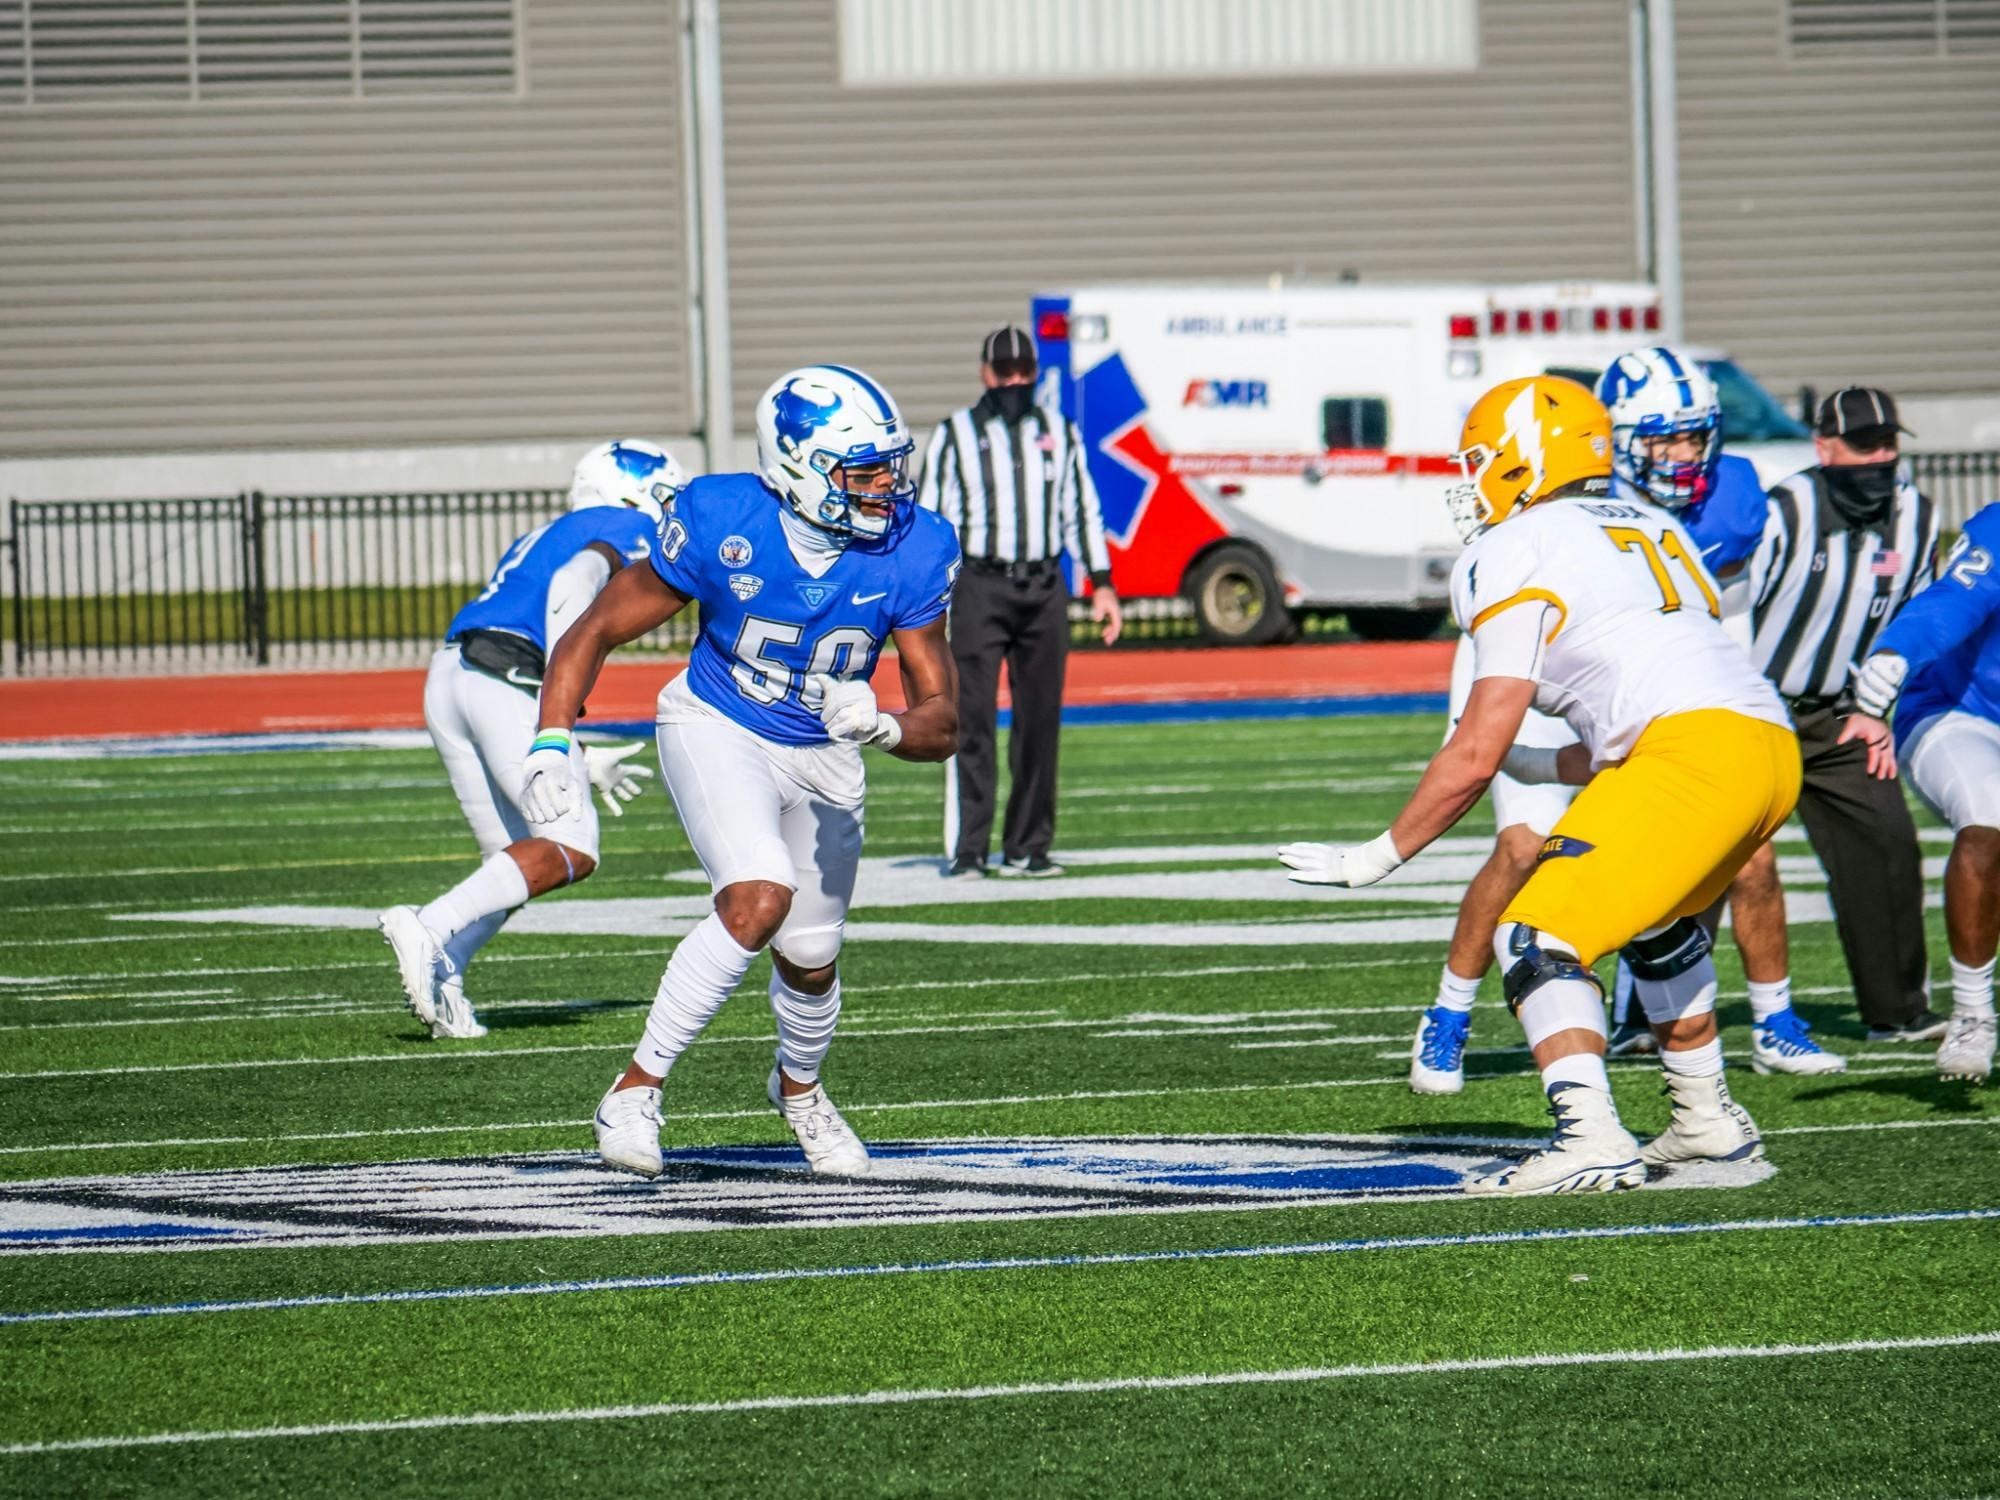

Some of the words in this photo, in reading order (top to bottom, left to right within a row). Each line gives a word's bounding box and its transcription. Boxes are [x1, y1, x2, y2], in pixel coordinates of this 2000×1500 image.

[1165, 315, 1288, 336] AMBULANCE
[1182, 378, 1268, 406] AMR
[1600, 524, 1721, 618] 71
[731, 613, 877, 713] 50
